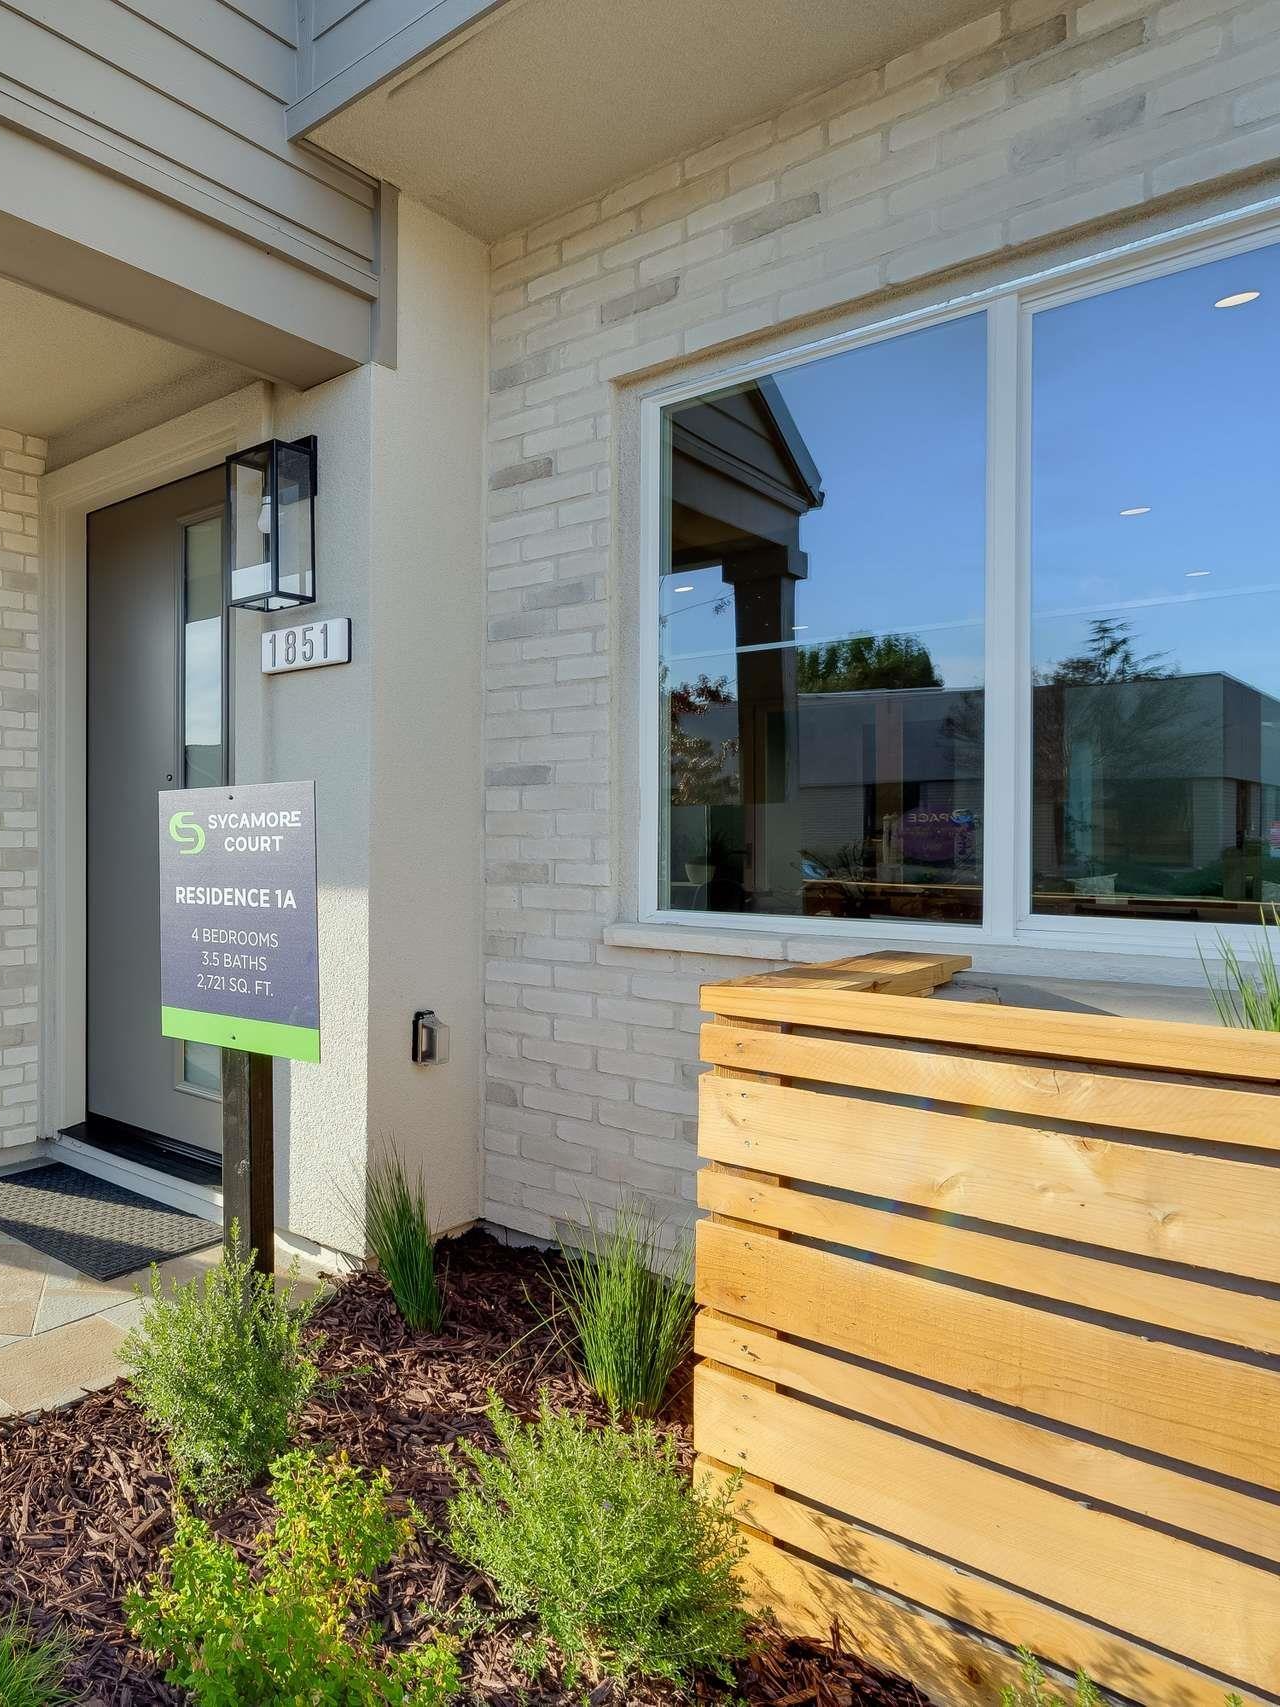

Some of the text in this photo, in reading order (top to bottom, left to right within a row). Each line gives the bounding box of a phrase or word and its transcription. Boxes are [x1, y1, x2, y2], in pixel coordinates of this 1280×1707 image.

[269, 623, 328, 668] 1851
[208, 811, 302, 829] SYCAMORE
[224, 836, 283, 852] COURT
[175, 886, 297, 909] RESIDENCE 1A
[191, 927, 279, 948] 4 BEDROOMS
[201, 951, 268, 972] 3.5 BATHS
[196, 974, 274, 997] 2,721 SQ. FT.
